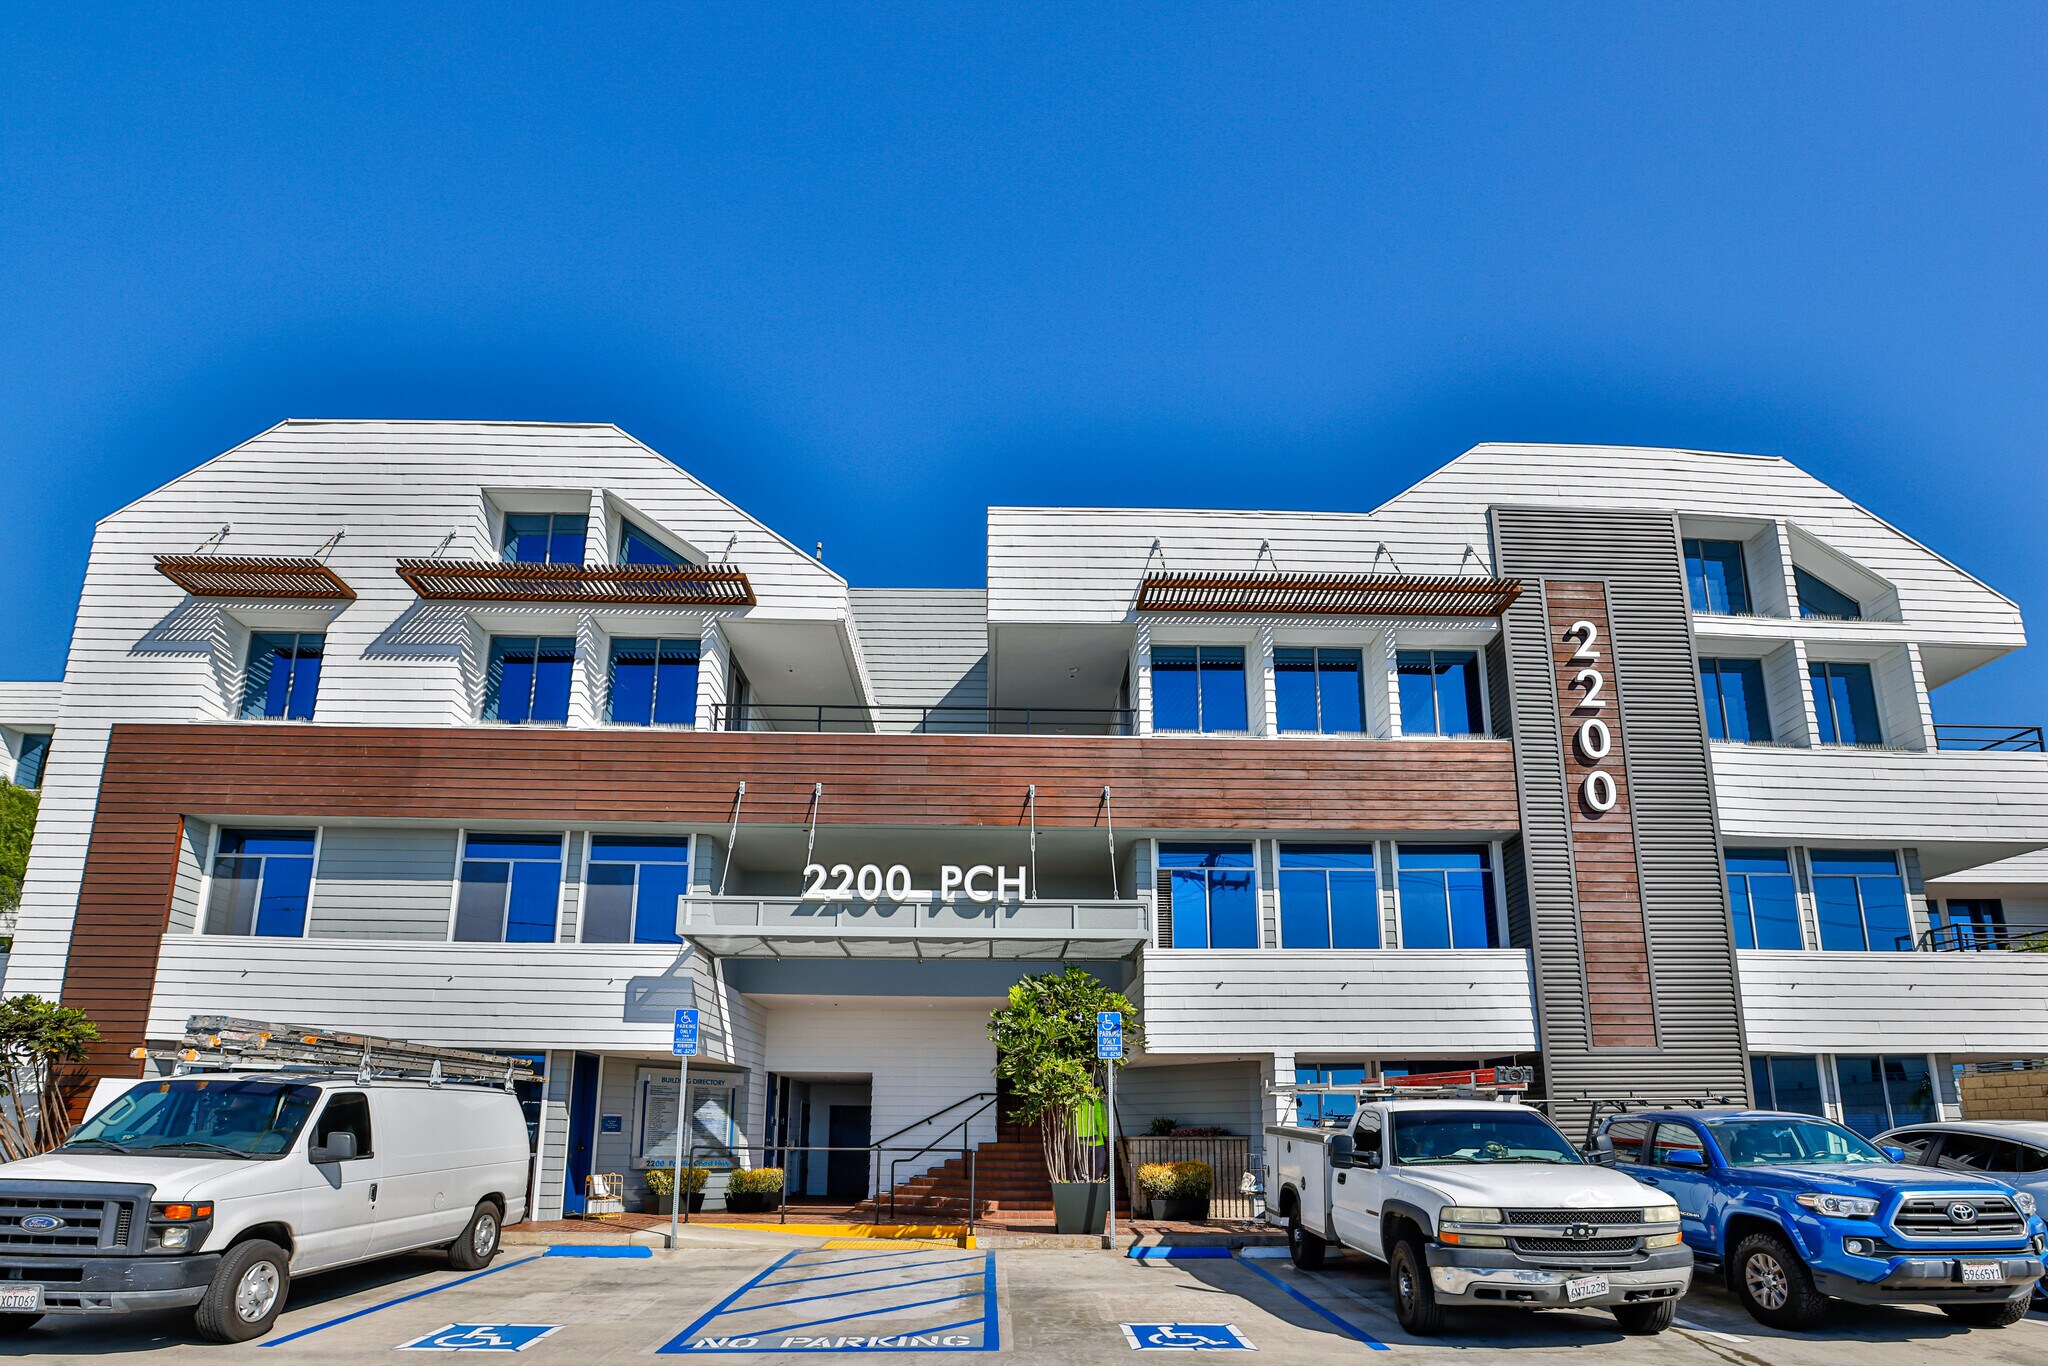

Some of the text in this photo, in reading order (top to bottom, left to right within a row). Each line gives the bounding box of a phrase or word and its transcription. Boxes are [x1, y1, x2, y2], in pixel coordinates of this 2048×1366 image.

[1568, 620, 1617, 813] 2200
[803, 863, 1027, 902] 2200 PCH
[661, 1076, 725, 1086] BUILDG DIRECTORY
[693, 1159, 713, 1167] Coast
[1963, 1268, 2001, 1280] 59665Y1
[0, 1295, 36, 1307] XCT069
[691, 1336, 971, 1349] NO PARKING
